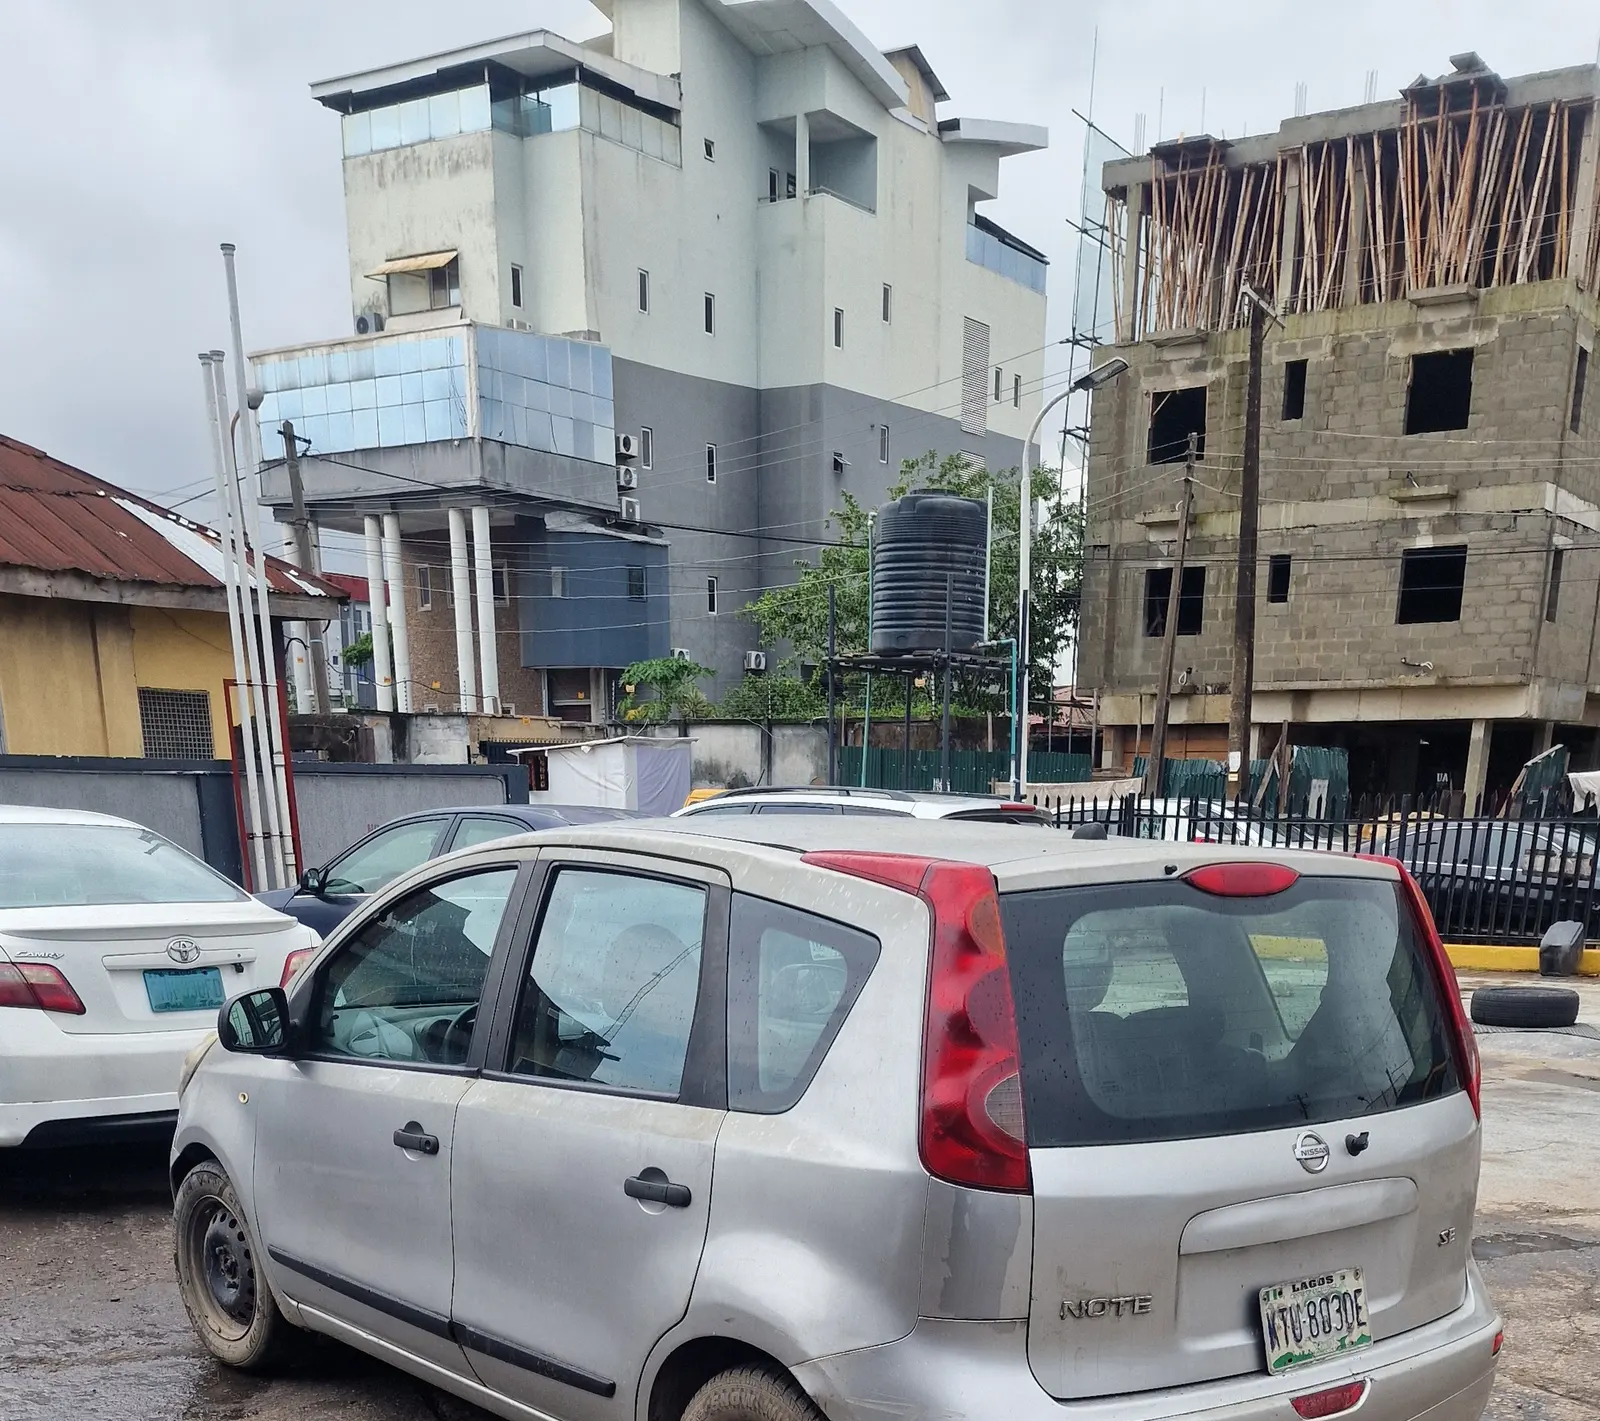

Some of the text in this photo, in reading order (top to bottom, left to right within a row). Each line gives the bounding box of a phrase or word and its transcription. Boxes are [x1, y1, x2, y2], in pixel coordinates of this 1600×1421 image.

[1300, 1145, 1329, 1157] NISSAN
[1291, 1274, 1334, 1293] LAGOS
[1059, 1294, 1152, 1321] NOTE
